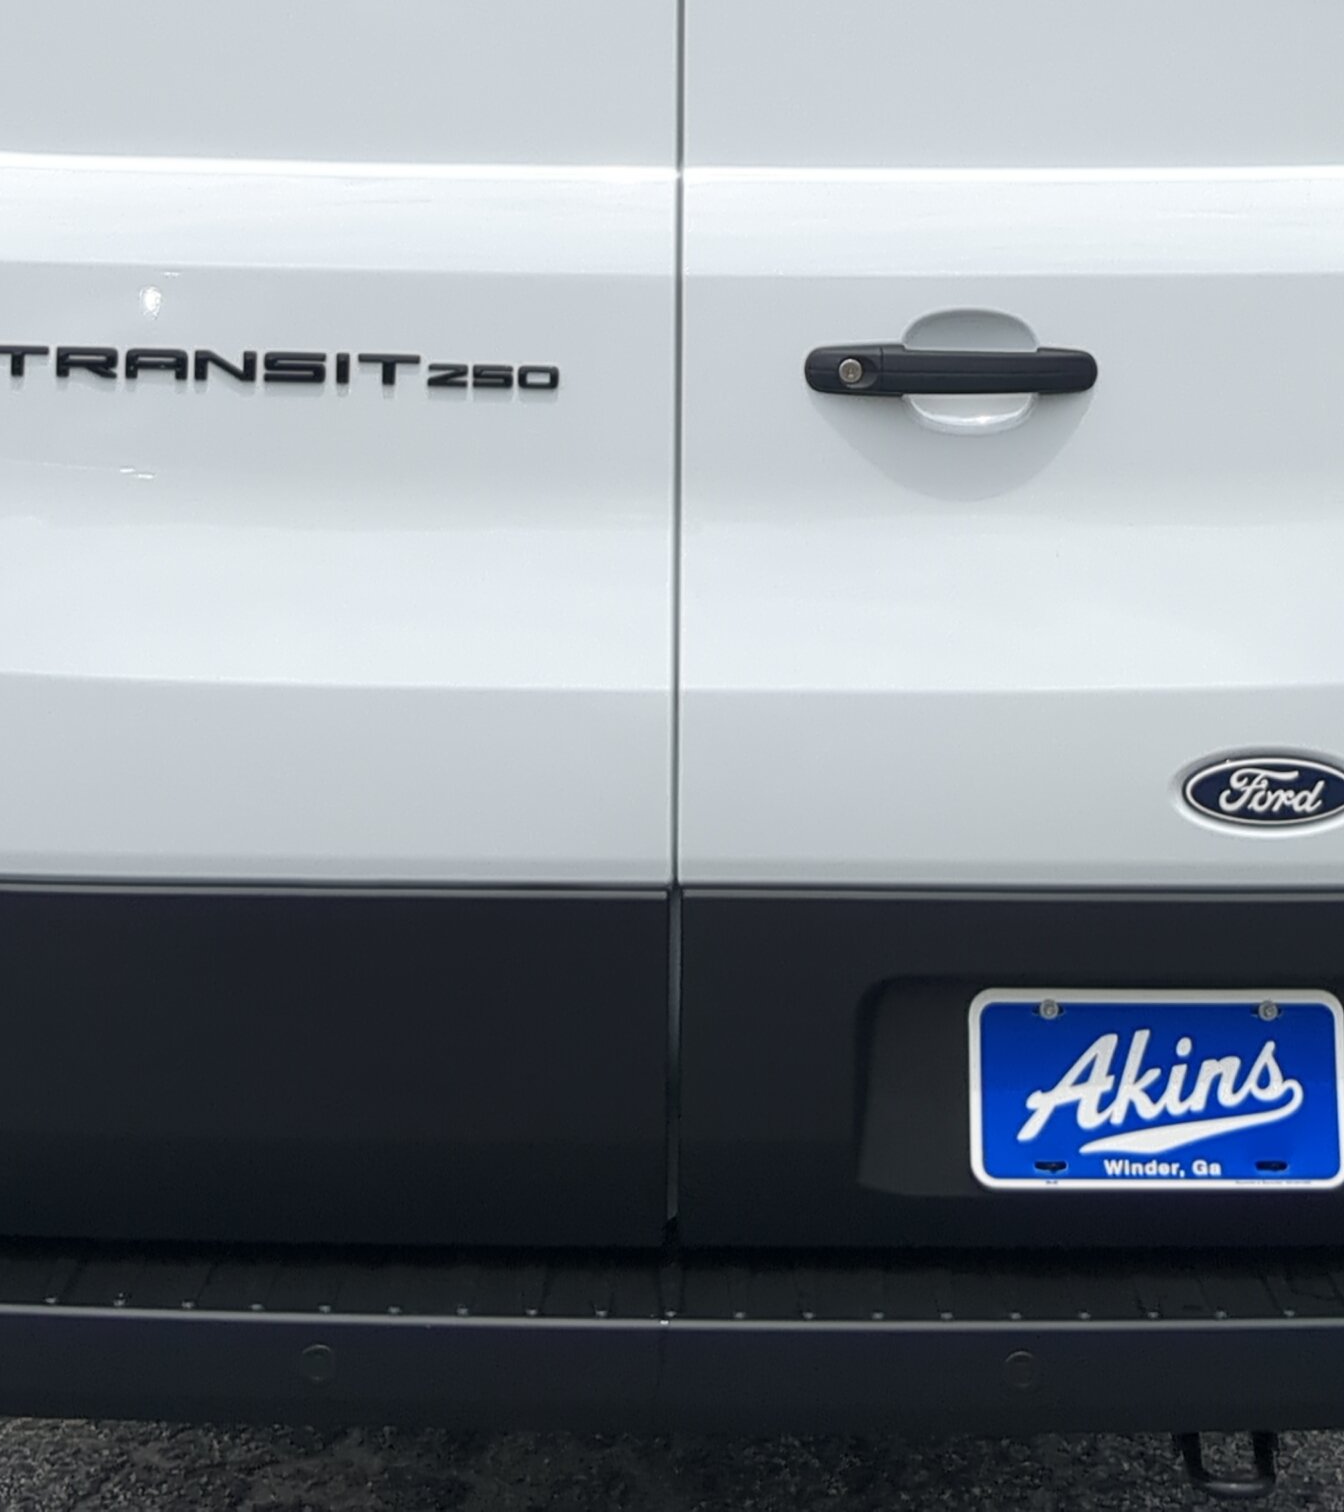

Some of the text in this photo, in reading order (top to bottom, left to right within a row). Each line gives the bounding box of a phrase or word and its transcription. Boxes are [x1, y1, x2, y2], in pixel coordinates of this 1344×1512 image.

[1219, 767, 1325, 813] Ford
[1017, 1029, 1288, 1143] Akins
[1104, 1159, 1223, 1178] Winder, Ga
